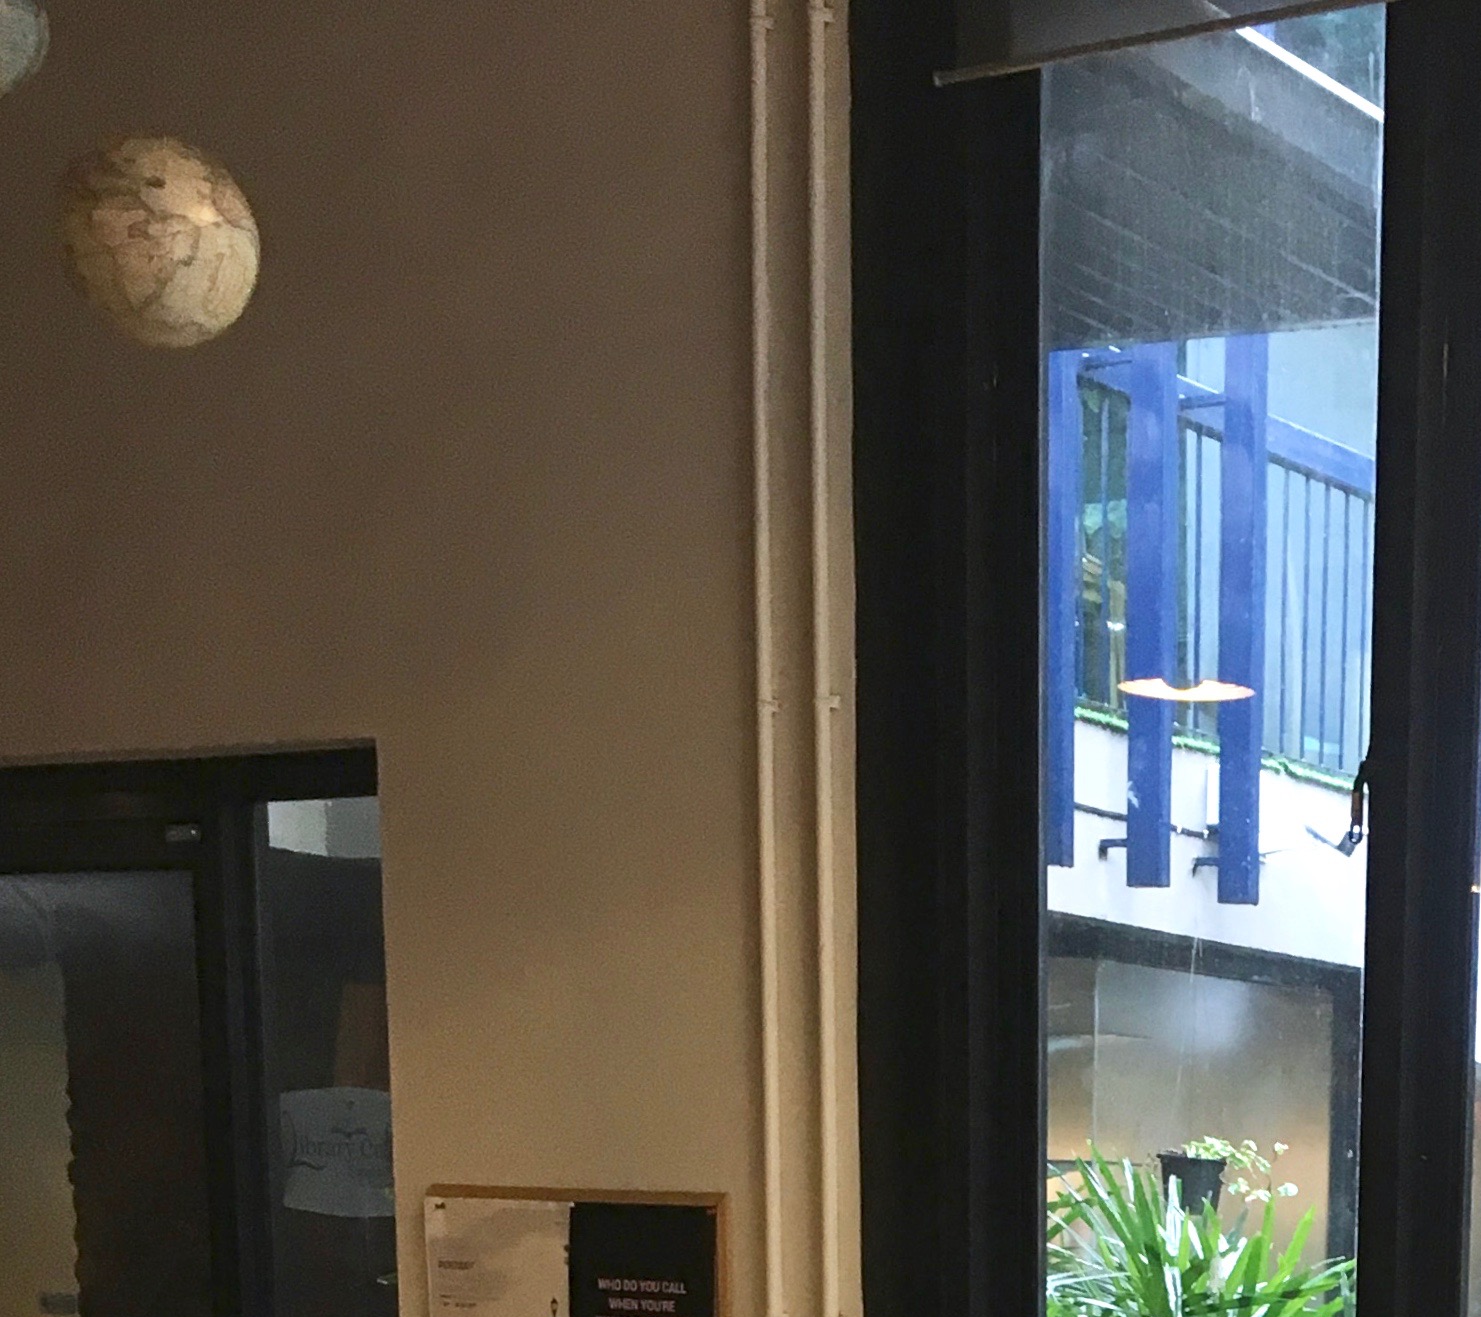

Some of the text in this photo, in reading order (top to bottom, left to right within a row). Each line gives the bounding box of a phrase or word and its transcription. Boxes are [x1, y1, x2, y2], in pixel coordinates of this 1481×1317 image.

[598, 1278, 687, 1294] WHO DO YOU CALL
[608, 1297, 676, 1312] WHEN YOU'RE
